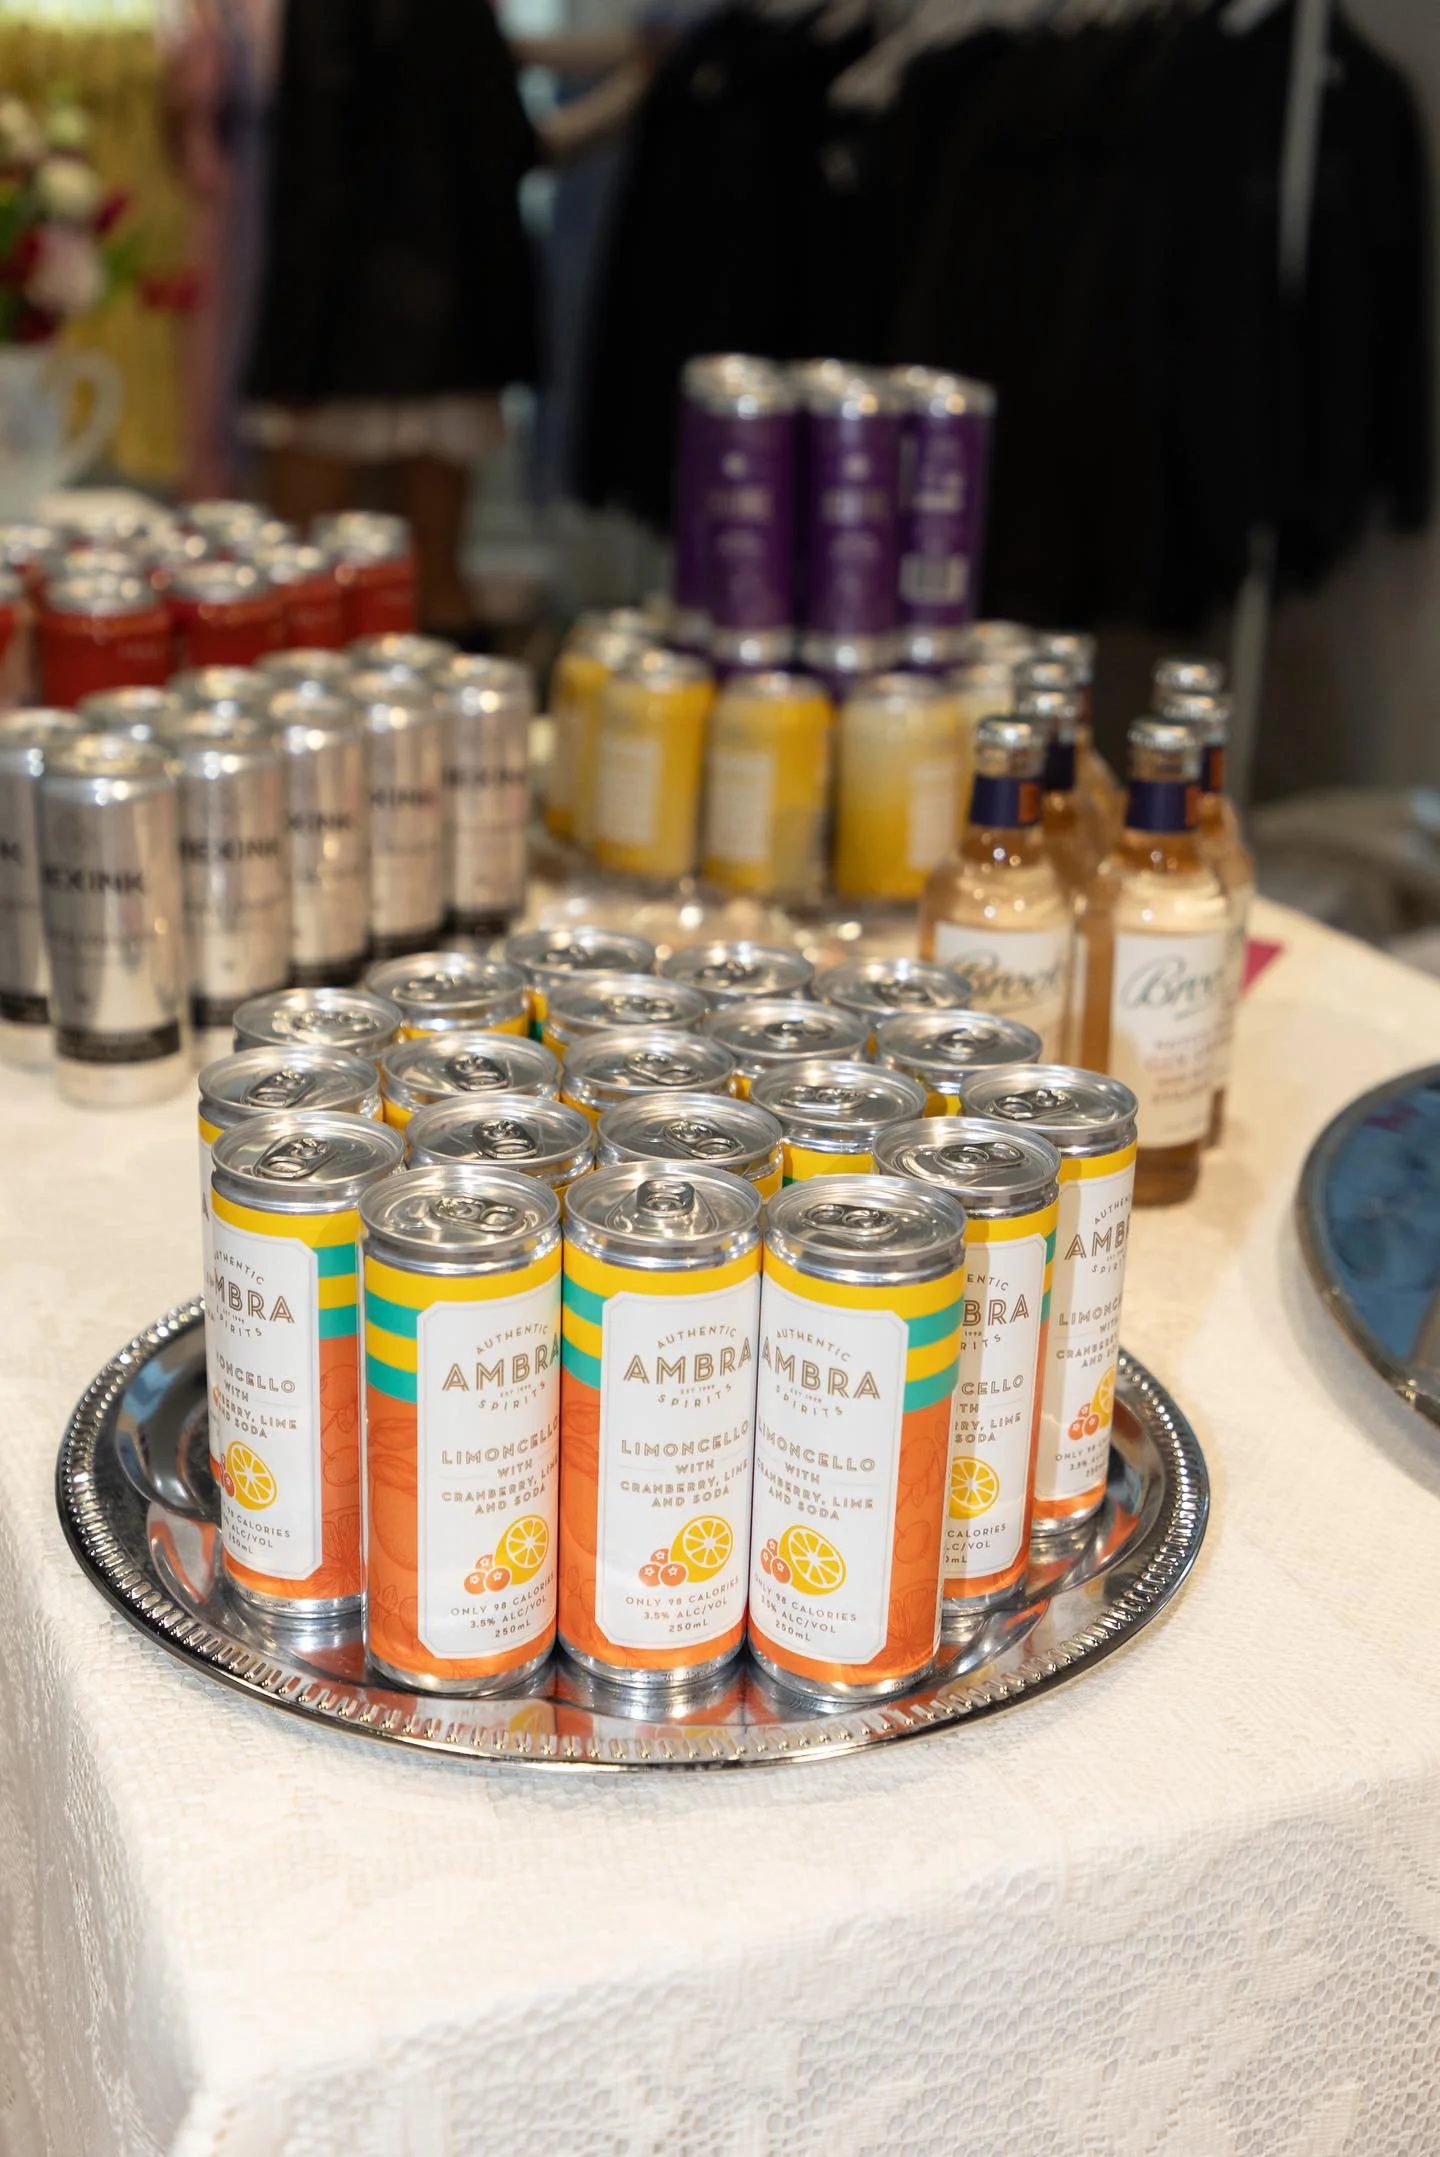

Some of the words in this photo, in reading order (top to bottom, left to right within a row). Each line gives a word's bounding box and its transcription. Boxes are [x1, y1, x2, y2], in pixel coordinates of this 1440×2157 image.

[1064, 1213, 1130, 1260] AMB
[967, 1274, 1009, 1291] ENTIC
[214, 1268, 295, 1324] MBRA
[962, 1294, 1029, 1326] BRA
[476, 1323, 548, 1355] AUTHENTIC
[657, 1325, 737, 1349] AUTHENTIC
[777, 1328, 851, 1362] AUTHENTIC
[960, 1334, 1001, 1351] RITS
[441, 1332, 559, 1391] AMBRA
[623, 1336, 752, 1384] AMBRA
[761, 1335, 881, 1400] AMBRA
[224, 1380, 249, 1402] WITH
[478, 1381, 545, 1412] SPIRITS
[657, 1383, 731, 1408] SPIRITS
[961, 1375, 1024, 1395] CELLO
[776, 1385, 843, 1418] SPIRITS
[960, 1403, 979, 1413] TH
[234, 1418, 267, 1438] SODA
[261, 1415, 297, 1429] LIME
[990, 1412, 1021, 1429] LIME
[441, 1415, 558, 1464] LIMONCELLO
[621, 1420, 748, 1457] LIMONCELLO
[955, 1432, 996, 1443] SODA
[497, 1458, 533, 1479] WITH
[620, 1476, 719, 1494] CRANBERRY,
[724, 1459, 747, 1481] LIME
[675, 1459, 714, 1474] WITH
[785, 1462, 820, 1484] WITH
[441, 1475, 537, 1502] CRANBERRY,
[475, 1500, 507, 1514] AND
[514, 1482, 545, 1506] SODA
[651, 1497, 685, 1508] AND
[692, 1485, 729, 1504] SODA
[769, 1486, 791, 1505] AND
[798, 1500, 840, 1520] SODA
[833, 1496, 874, 1509] LIME
[231, 1524, 273, 1548] ALC/VOL
[237, 1515, 291, 1538] CALORIES
[947, 1523, 1006, 1538] CALORIES
[946, 1541, 991, 1551] C/VOL
[450, 1606, 487, 1616] ONLY
[494, 1601, 507, 1611] 98
[512, 1572, 554, 1606] CALORIES
[625, 1596, 661, 1606] ONLY
[689, 1576, 738, 1603] CALORIES
[470, 1617, 495, 1629] 3.5%
[502, 1595, 547, 1623] ALC/VOL
[644, 1612, 669, 1620] 3.5%
[677, 1598, 727, 1619] ALC/VOL
[776, 1593, 786, 1604] 98
[792, 1602, 856, 1621] CALORIES
[495, 1619, 531, 1638] 250mL
[669, 1619, 708, 1633] 250mL
[776, 1620, 811, 1641] 250mL
[782, 1611, 836, 1633] ALC/VOL
